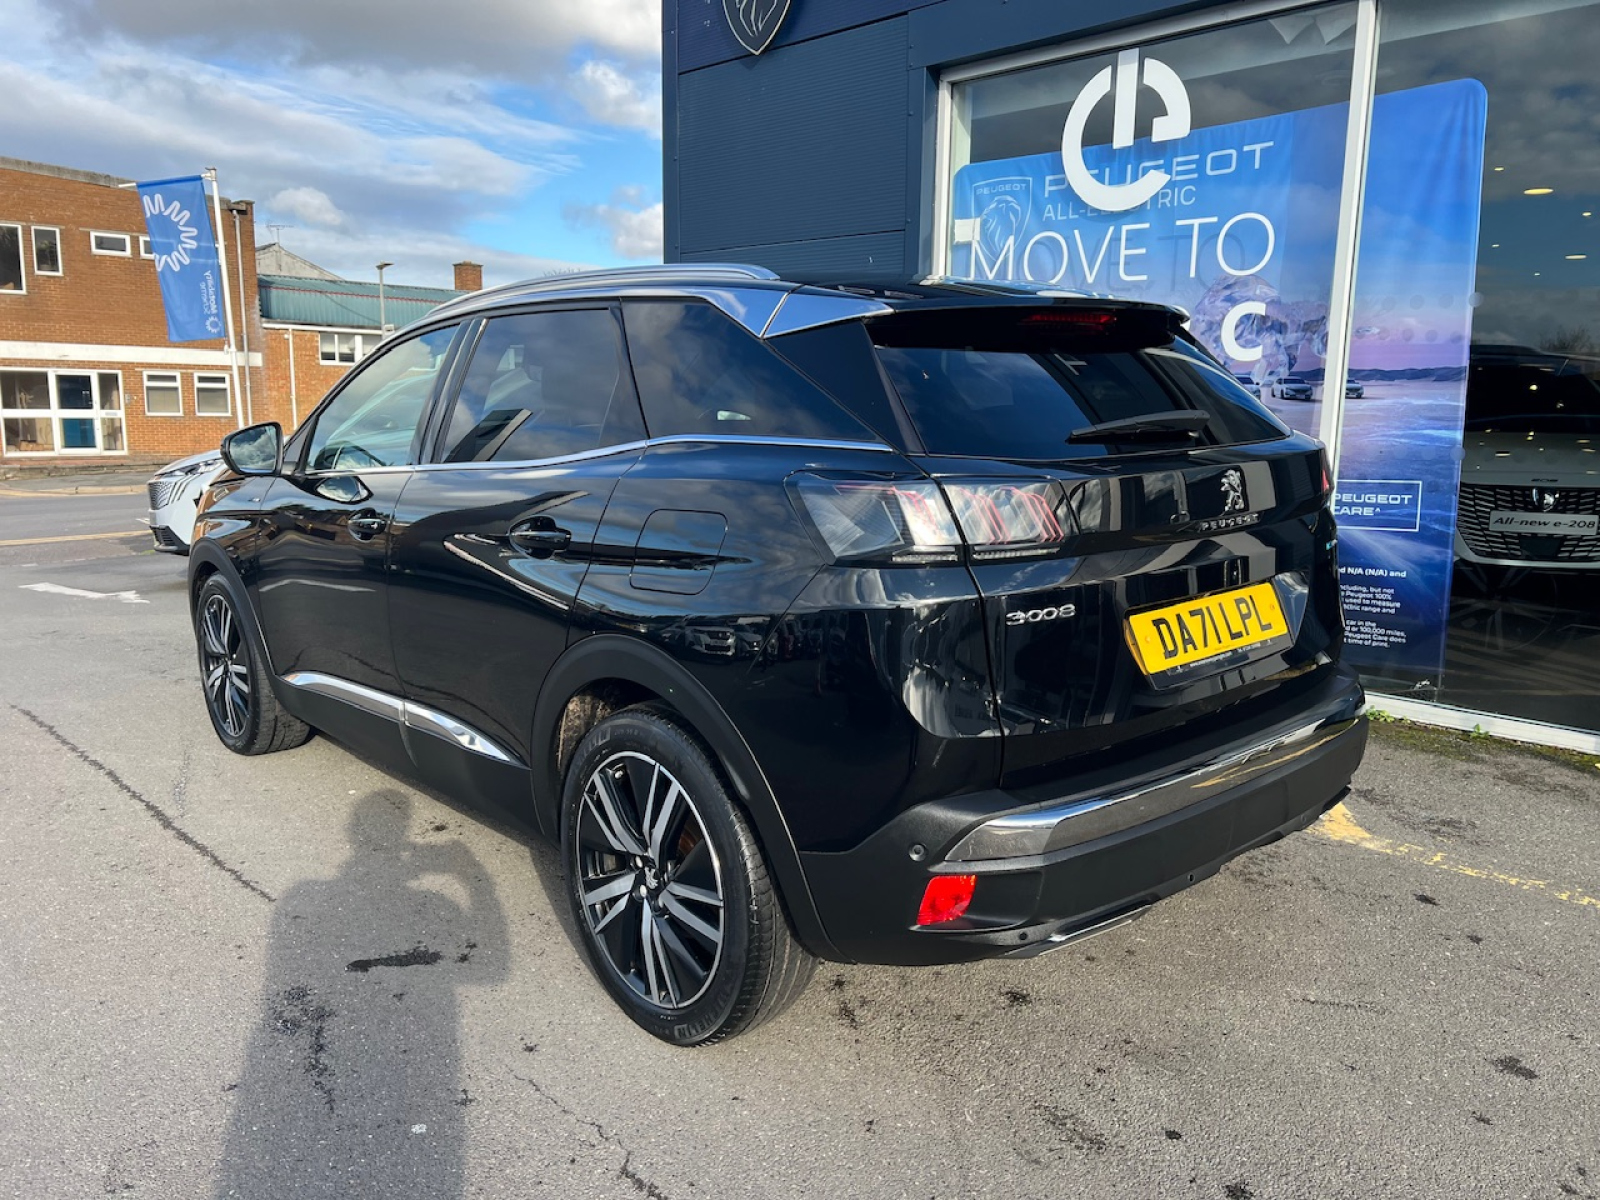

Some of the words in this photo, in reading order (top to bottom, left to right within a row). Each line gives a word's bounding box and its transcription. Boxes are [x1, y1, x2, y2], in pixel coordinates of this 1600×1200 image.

[1045, 142, 1274, 197] PUGEOT
[975, 183, 1027, 195] PEUGEOT
[1042, 185, 1197, 221] ALL-RIC
[970, 223, 1150, 283] MOVE
[1175, 212, 1275, 277] TO
[1200, 513, 1259, 531] PEUGEOT
[1493, 517, 1550, 527] All-new
[1553, 520, 1596, 529] e-208
[1347, 567, 1364, 576] N/A
[1365, 568, 1388, 577] (N/A)
[1389, 570, 1407, 578] and
[1371, 600, 1401, 608] measure
[1006, 604, 1076, 625] 3008
